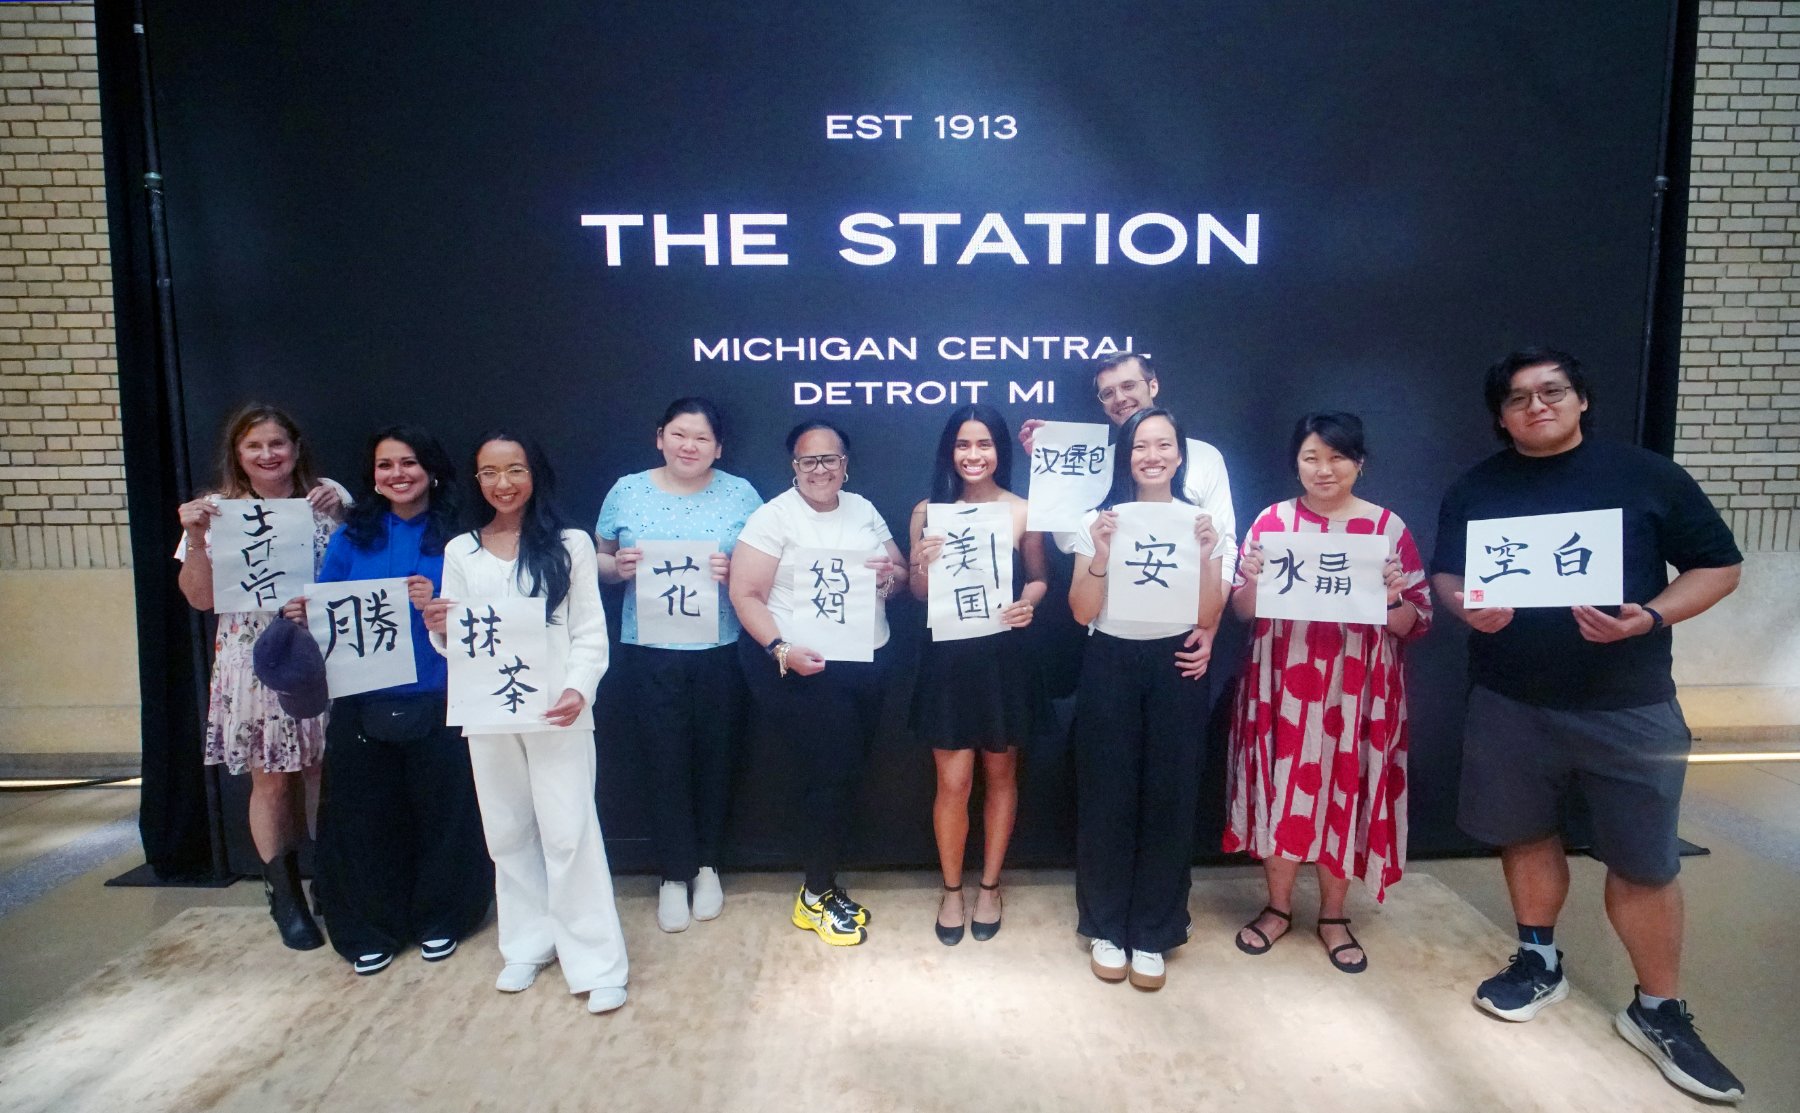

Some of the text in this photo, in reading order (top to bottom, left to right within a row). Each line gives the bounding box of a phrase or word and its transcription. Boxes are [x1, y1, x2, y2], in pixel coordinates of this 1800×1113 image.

[826, 114, 1018, 140] EST 1913
[581, 212, 1260, 267] THE STATION
[693, 336, 917, 362] MICHIGAN
[794, 380, 1055, 405] DETROIT MI
[1034, 444, 1106, 476] 汉堡包
[1125, 535, 1178, 588] 安
[1270, 548, 1352, 596] 水晶
[1479, 532, 1593, 583] 空白
[653, 556, 701, 617] 花
[809, 557, 850, 625] 妈妈
[324, 588, 399, 664] 勝
[459, 604, 538, 714] 抹茶
